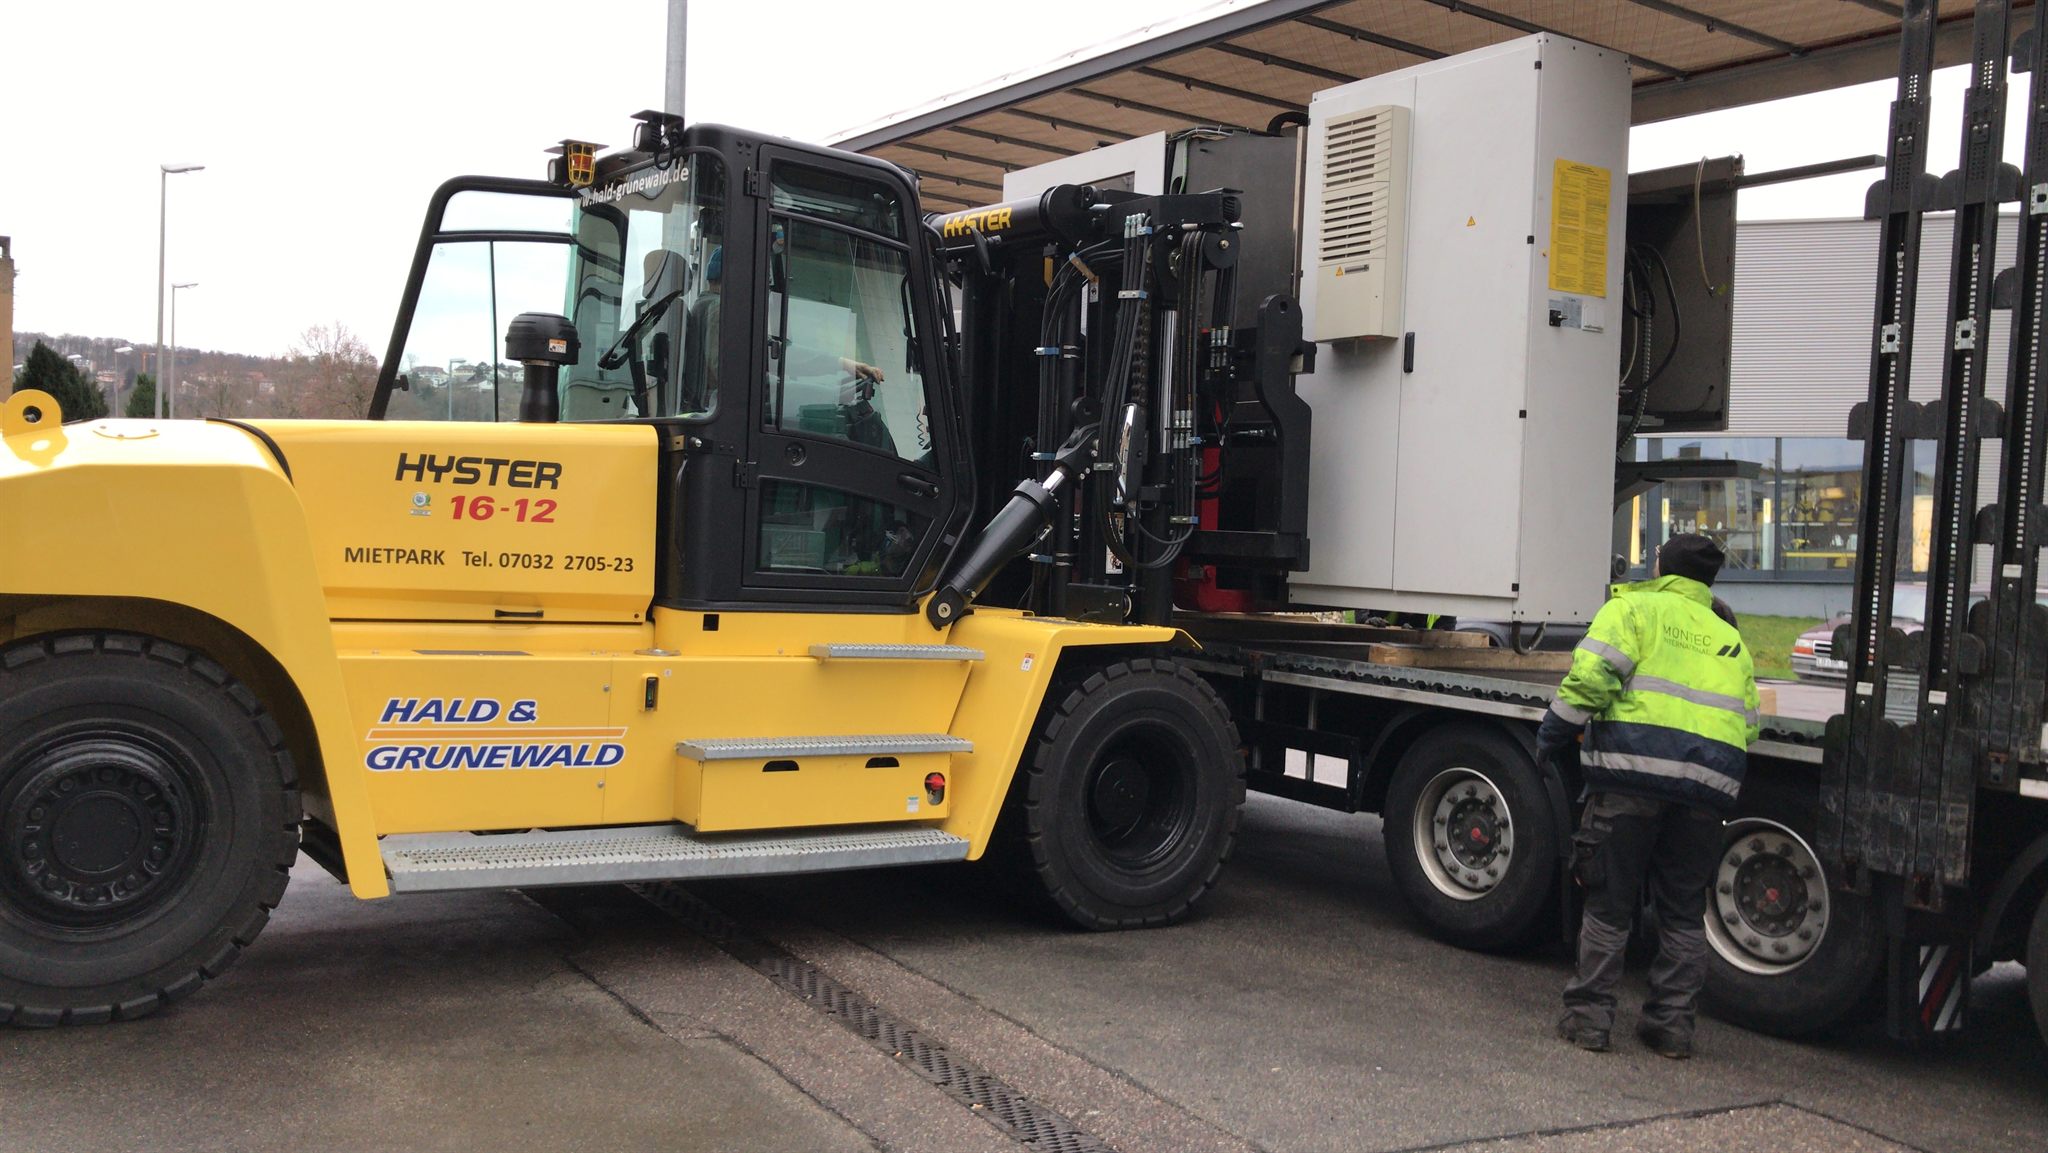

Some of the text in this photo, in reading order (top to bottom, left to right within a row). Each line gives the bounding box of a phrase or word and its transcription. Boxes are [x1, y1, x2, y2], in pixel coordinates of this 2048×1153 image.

[943, 207, 1012, 238] HYSTER
[395, 452, 562, 490] HYSTER
[451, 495, 557, 523] 16-12
[344, 547, 634, 572] MIETPARK Tel. 07032 2705-23
[1663, 624, 1712, 646] MONTEC
[379, 699, 537, 723] HALD &
[366, 744, 624, 771] GRUNEWALD
